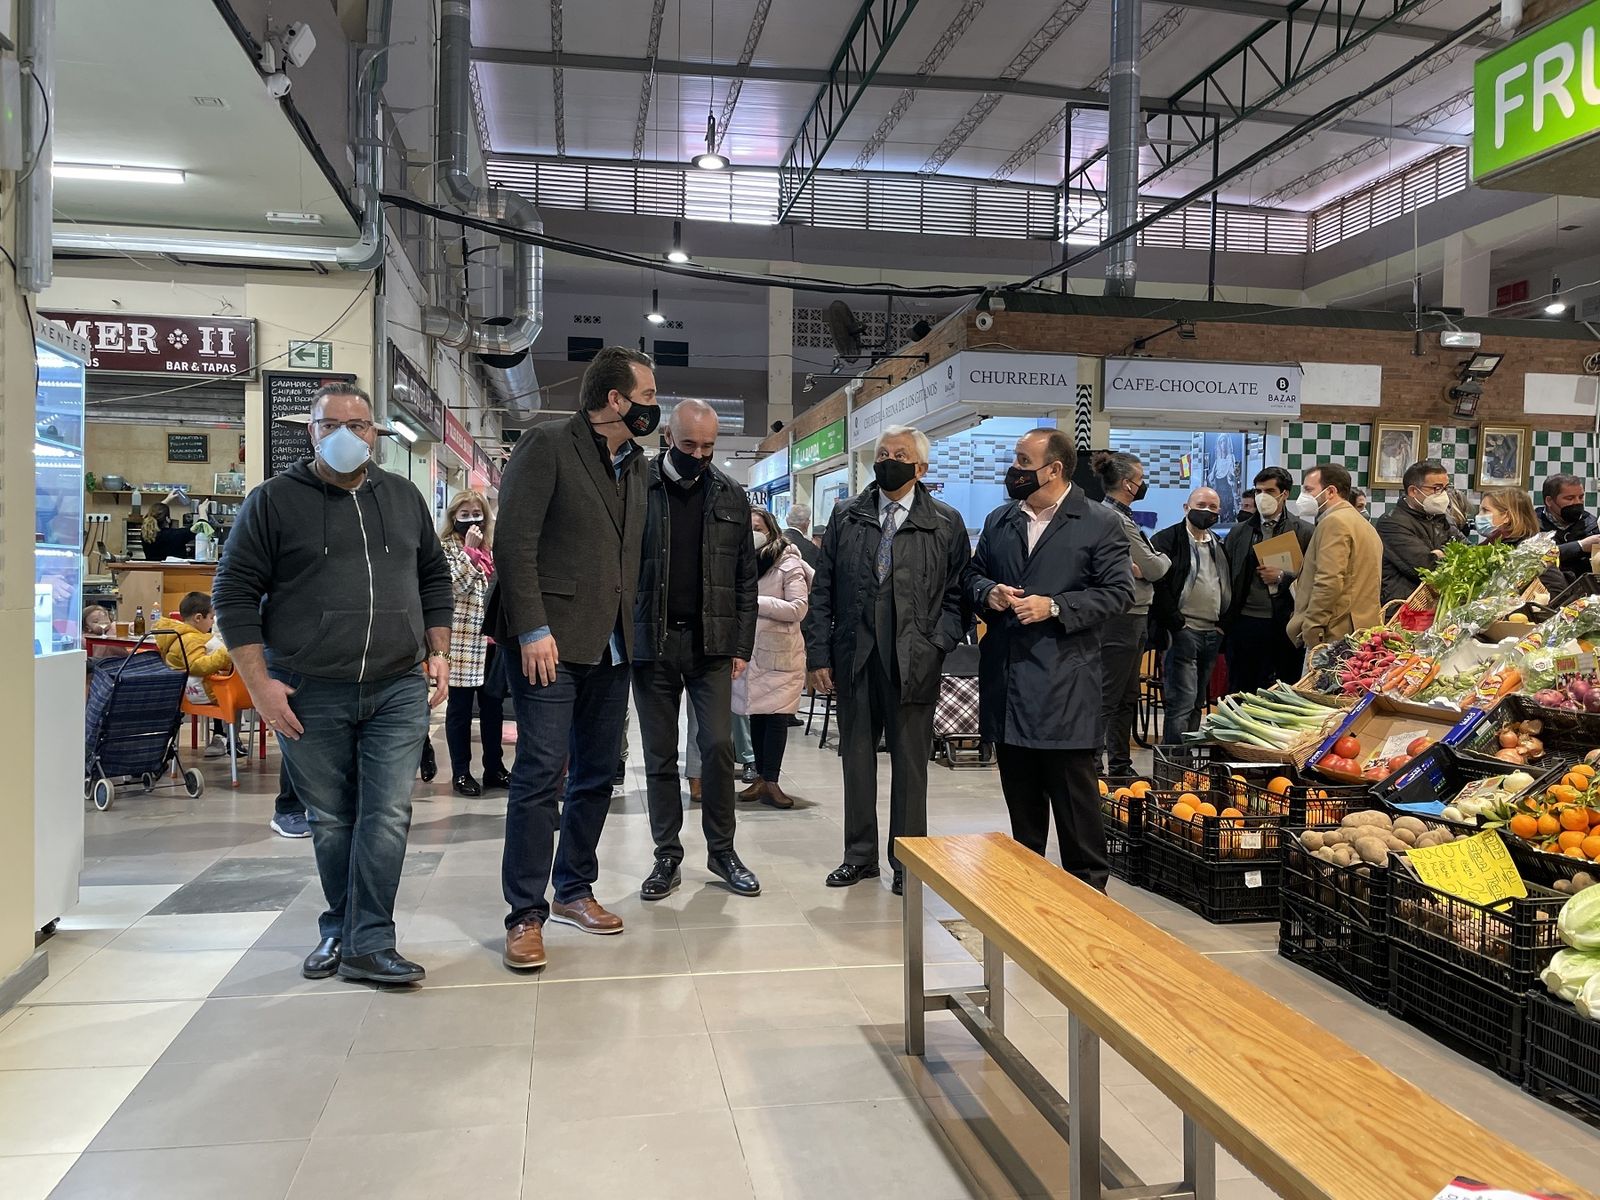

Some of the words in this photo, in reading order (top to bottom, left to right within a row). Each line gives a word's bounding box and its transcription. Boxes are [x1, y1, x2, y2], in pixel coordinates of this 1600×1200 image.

[198, 326, 236, 357] II
[321, 343, 330, 368] SALIDA
[166, 361, 189, 371] BAR
[191, 362, 200, 371] &
[202, 363, 237, 373] TAPAS
[969, 370, 1067, 386] CHURRERIA
[1112, 377, 1259, 395] CAFE-CHOCOLATE
[1268, 394, 1296, 403] BAZAR
